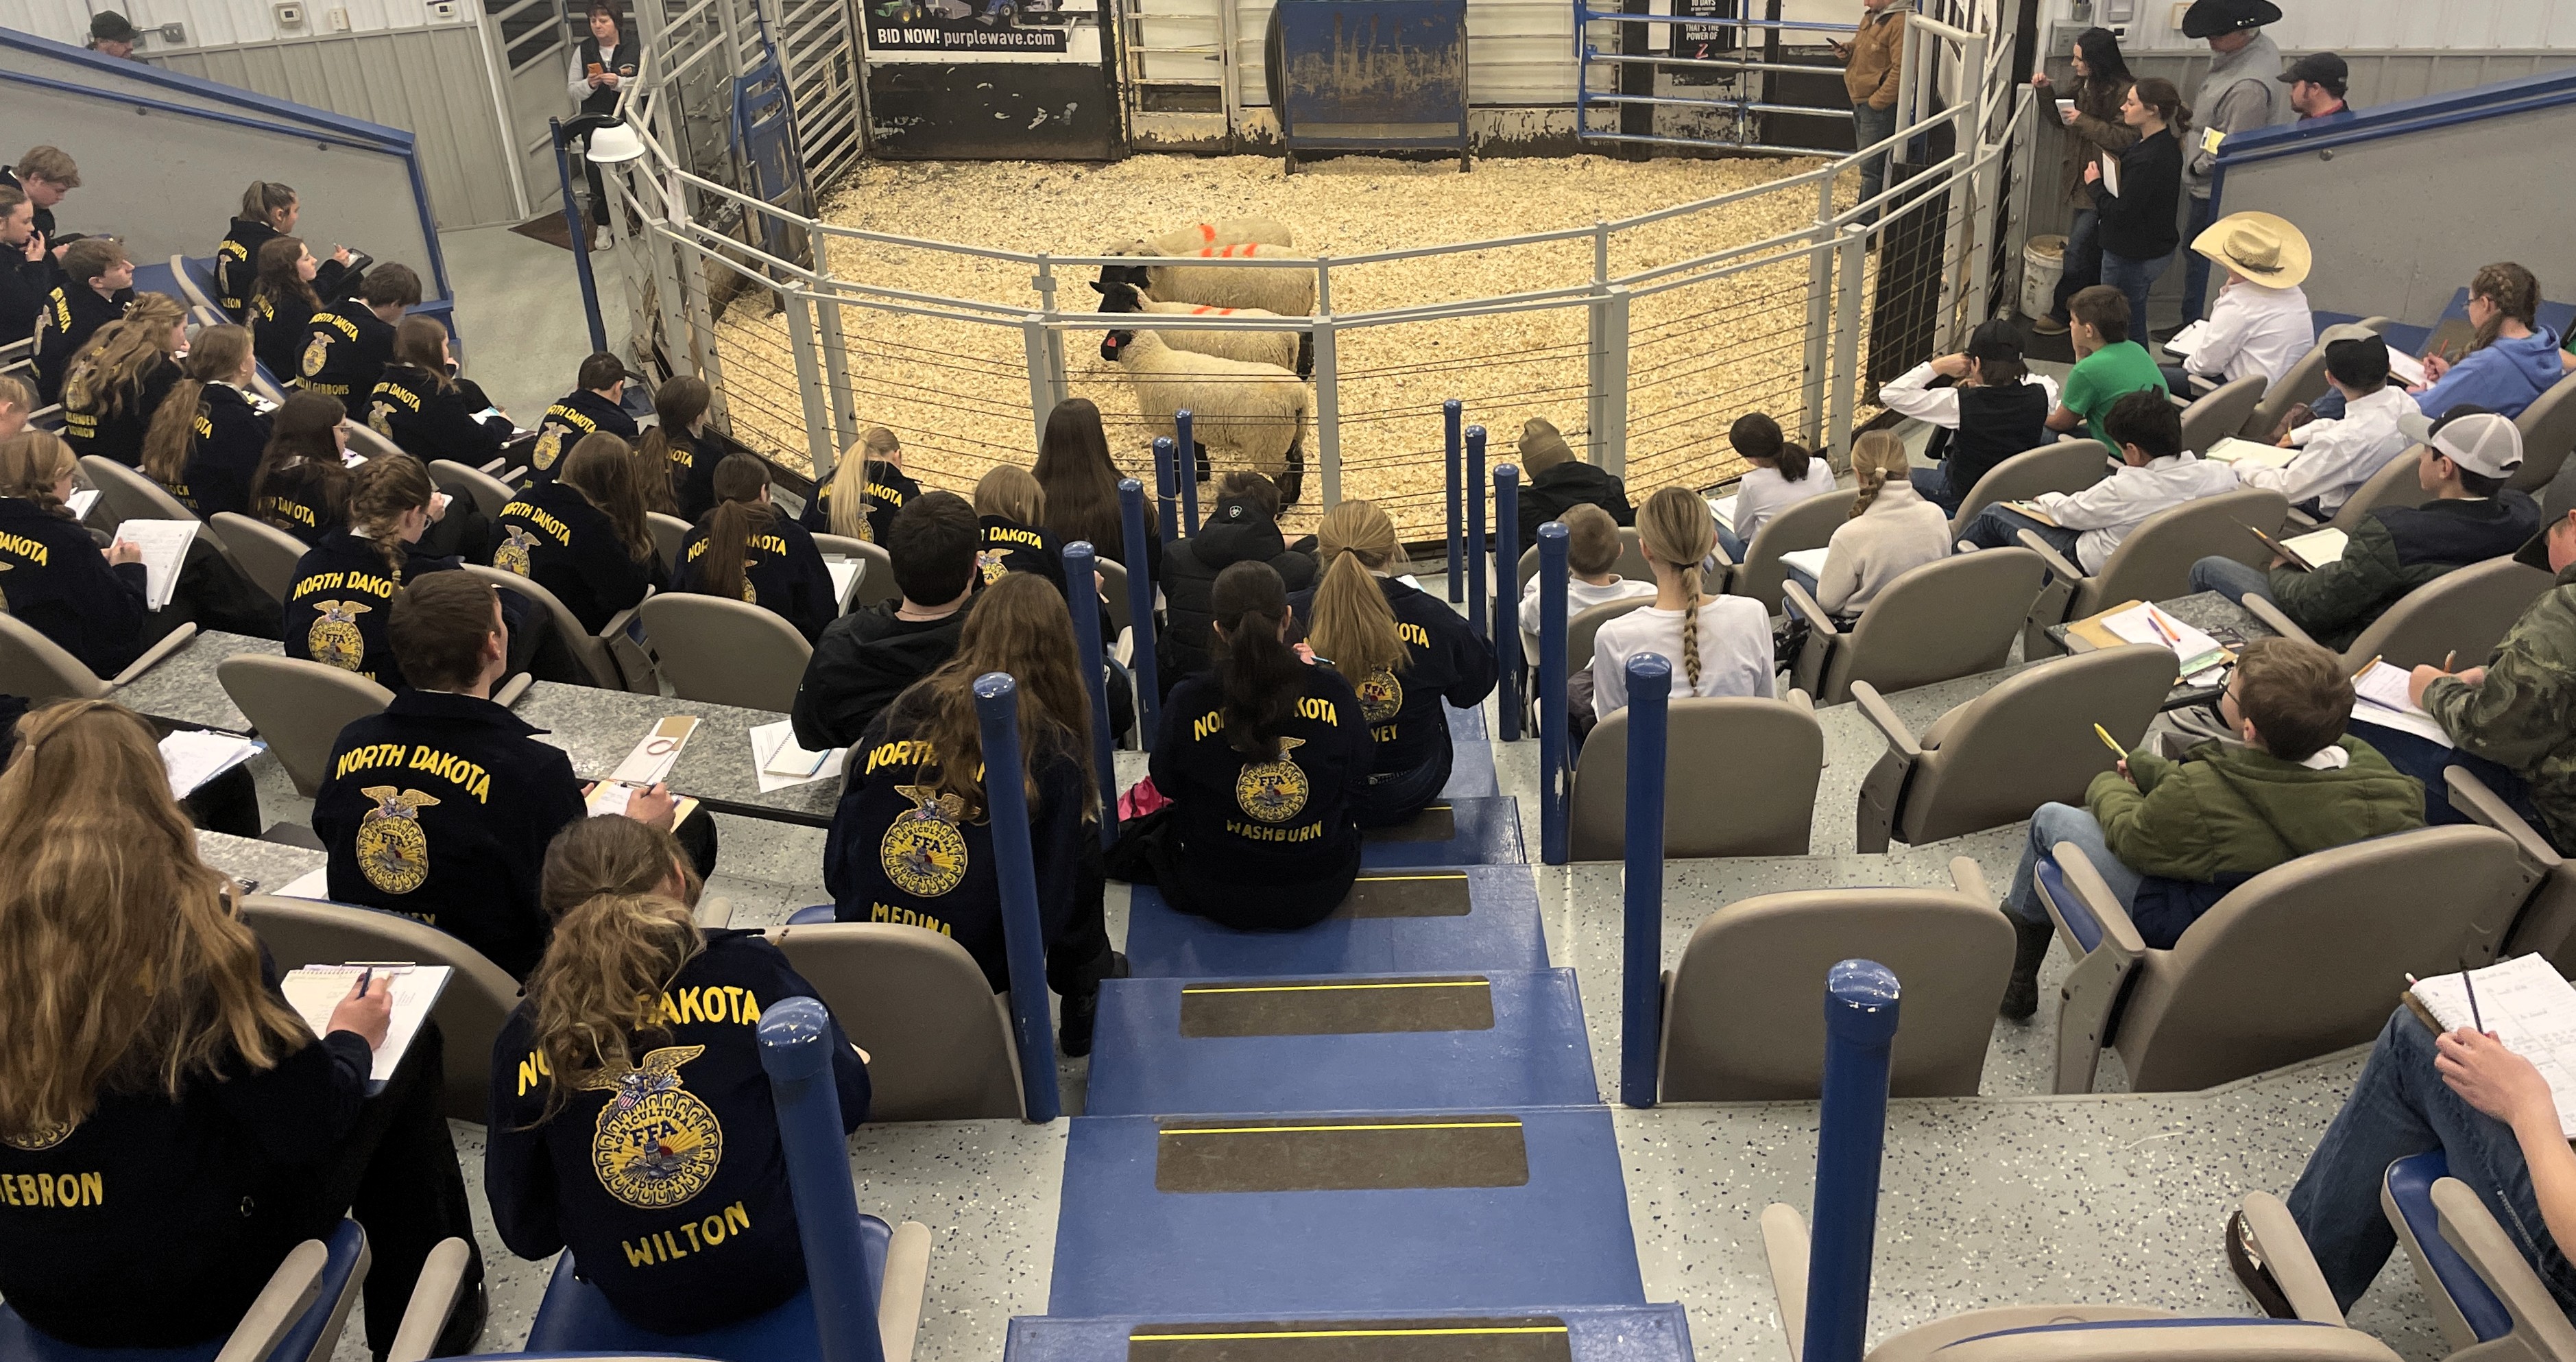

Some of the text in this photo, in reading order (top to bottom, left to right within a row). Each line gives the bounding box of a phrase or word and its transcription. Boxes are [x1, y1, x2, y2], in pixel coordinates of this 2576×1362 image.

[878, 29, 1055, 47] BID NOW! purplewave.com
[1687, 32, 1718, 40] POWER OF
[332, 315, 359, 342] DAKOTA
[389, 383, 421, 413] DAKOTA
[194, 416, 213, 439] OTA
[564, 408, 597, 433] DAKOTA
[531, 507, 570, 547] DAKOTA
[989, 526, 1042, 549] DAKOTA
[687, 534, 786, 563] NOR AKOTA
[292, 571, 392, 601] NORTH DAKO
[326, 634, 346, 643] FFA
[1394, 621, 1430, 649] OTA
[1364, 684, 1386, 697] FFA
[1295, 696, 1338, 727] KOTA
[1371, 724, 1399, 743] VEY
[336, 744, 490, 804] NORTH DAKOTA
[1259, 775, 1286, 787] FFA
[381, 832, 406, 848] FFA
[911, 834, 942, 853] FFA
[1227, 820, 1322, 842] WASHBURN
[871, 902, 952, 937] MEDINA
[614, 1108, 696, 1154] AGRICULTURAL
[629, 1119, 679, 1147] FFA
[0, 1172, 102, 1208] EBRON
[621, 1200, 750, 1267] WILTON
